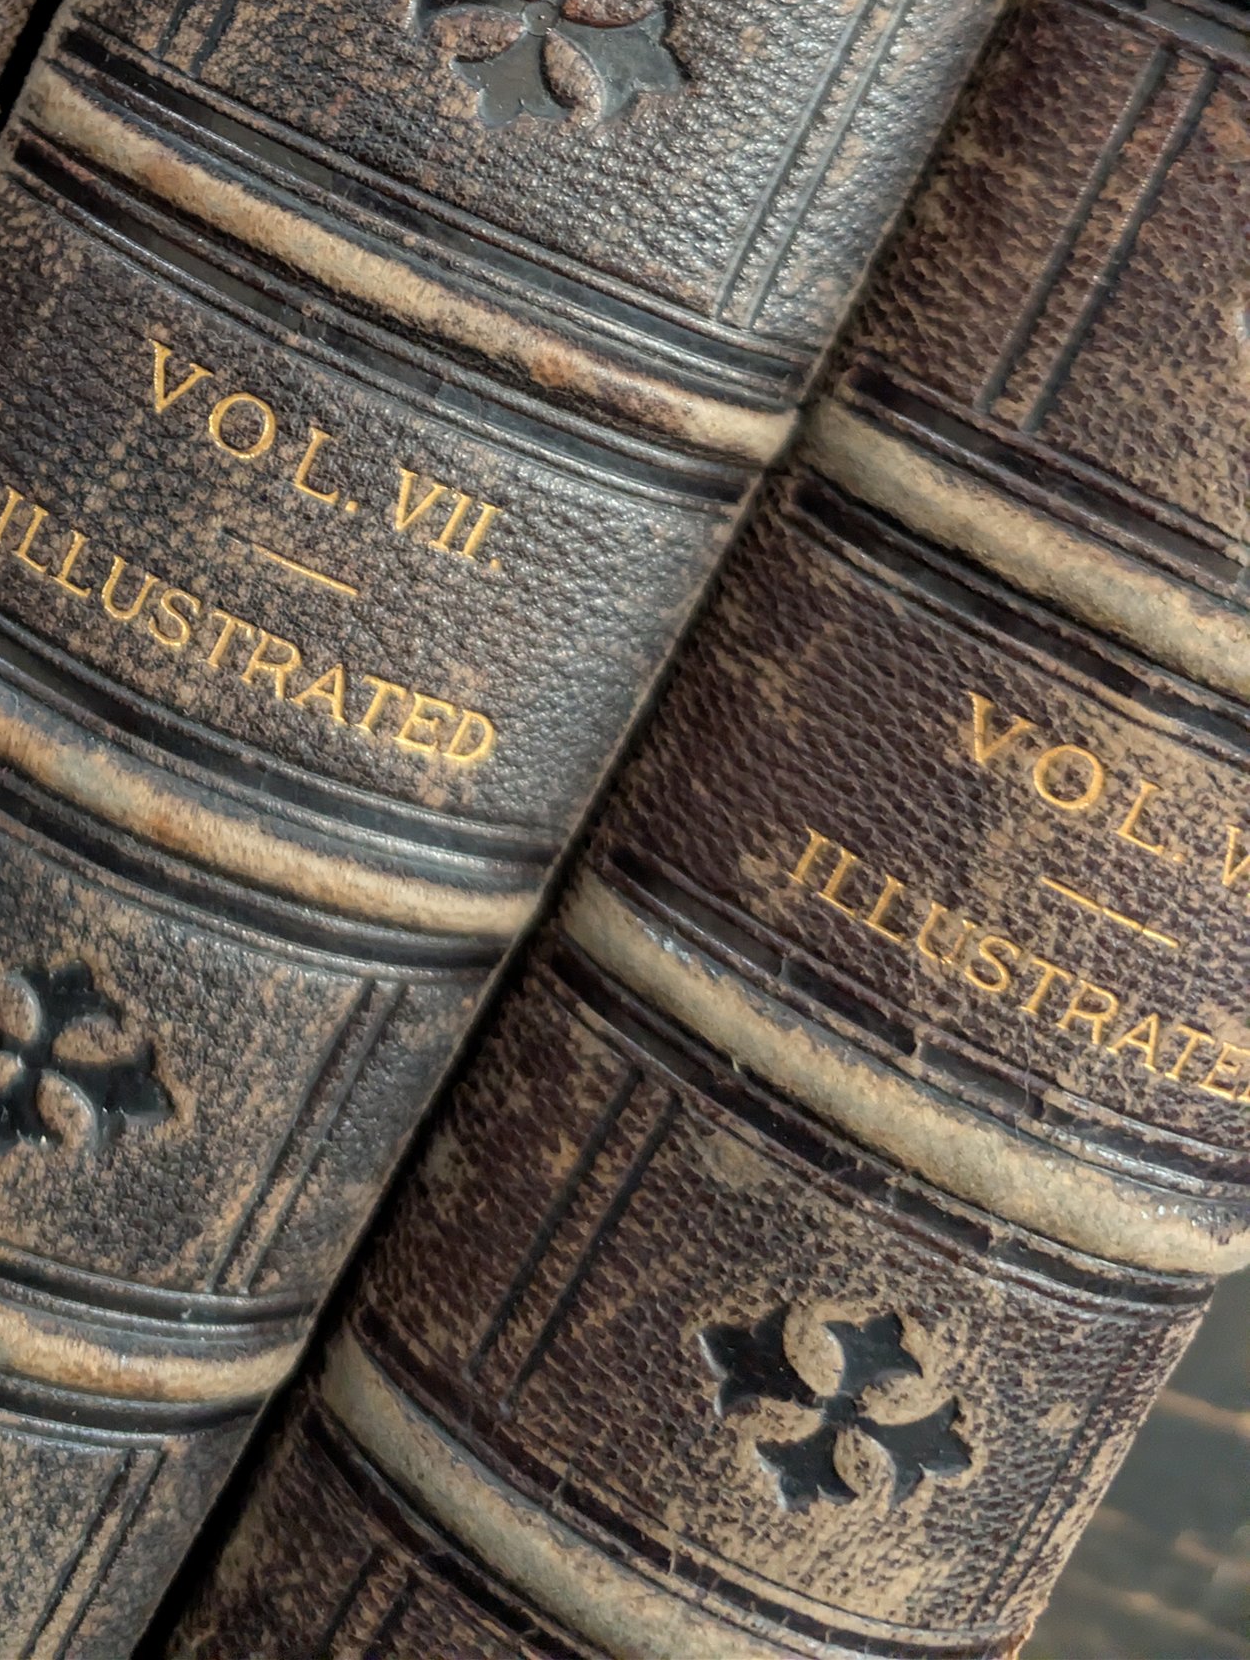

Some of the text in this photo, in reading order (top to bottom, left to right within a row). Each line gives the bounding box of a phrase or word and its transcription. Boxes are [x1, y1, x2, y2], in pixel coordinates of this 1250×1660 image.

[149, 339, 502, 570] VOL. VII.
[967, 690, 1187, 863] VOL.
[787, 825, 1250, 1104] ILLUSTRATE
